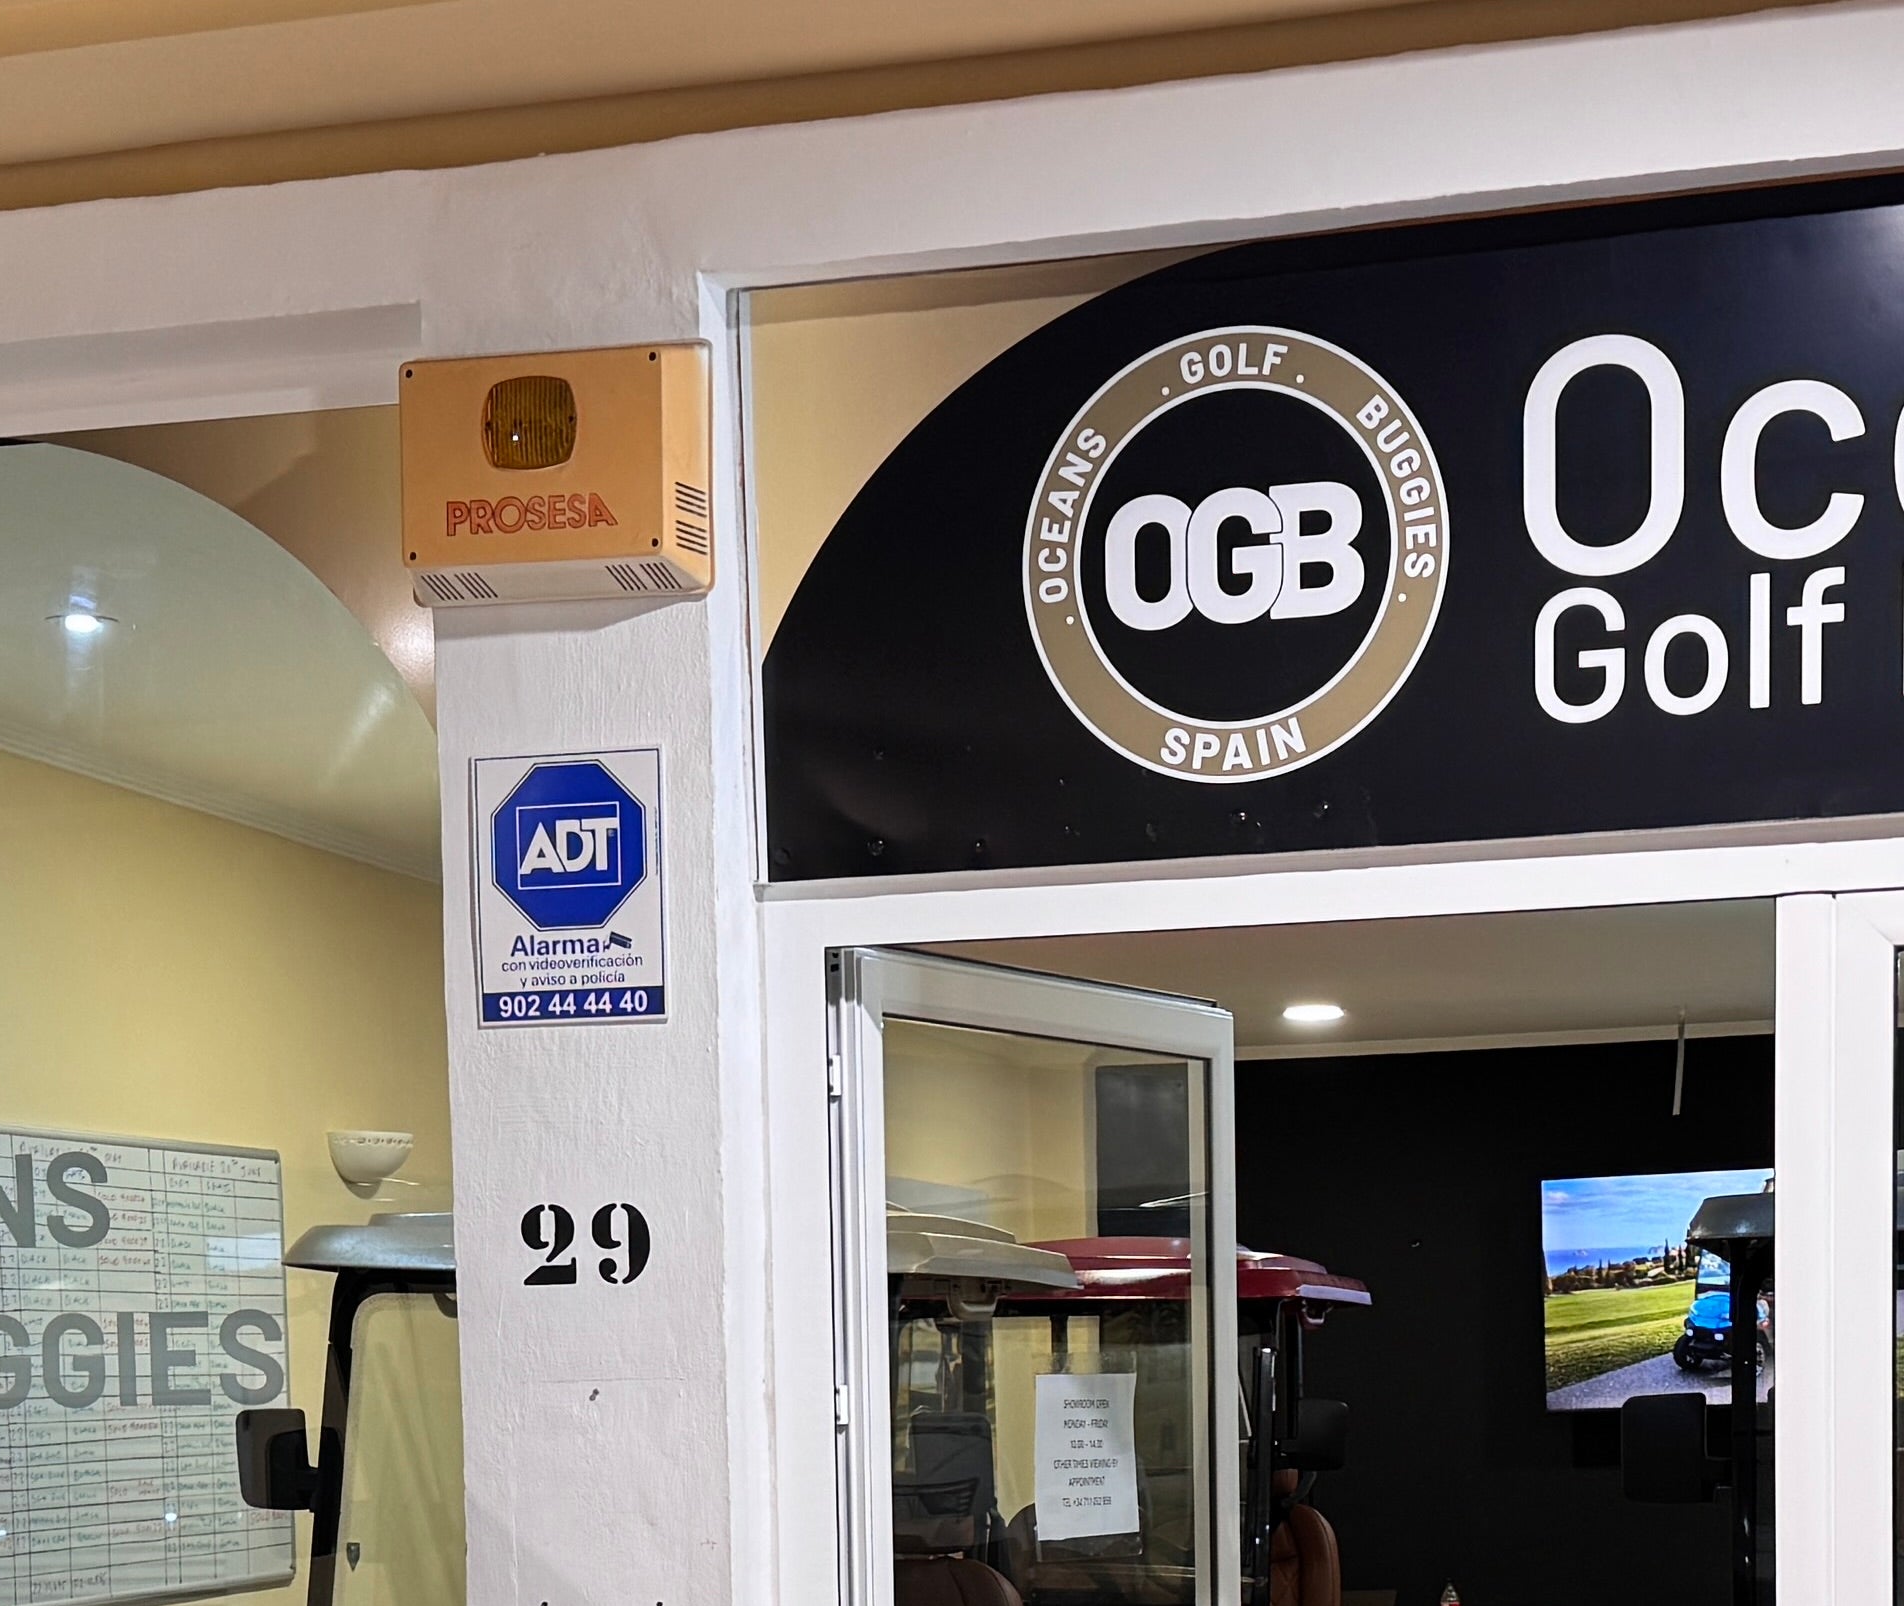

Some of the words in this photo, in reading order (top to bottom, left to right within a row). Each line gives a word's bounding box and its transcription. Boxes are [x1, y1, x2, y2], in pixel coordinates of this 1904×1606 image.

[1180, 343, 1288, 384] GOLF
[1356, 394, 1437, 579] BUGGIES
[446, 493, 617, 537] PROSESA
[1038, 427, 1107, 604] OCEANS
[1105, 481, 1365, 631] OGB
[1534, 565, 1847, 724] Golf
[1160, 717, 1306, 771] SPAIN
[519, 813, 618, 879] ADT
[502, 961, 526, 972] con
[530, 953, 643, 971] videoverificación
[510, 935, 600, 957] Alarma
[499, 995, 541, 1017] 902
[548, 993, 576, 1015] 44
[584, 991, 612, 1014] 44
[619, 990, 648, 1012] 40
[520, 978, 527, 989] y
[532, 973, 566, 987] aviso
[570, 975, 577, 984] a
[582, 971, 625, 986] policía
[521, 1204, 651, 1286] 29
